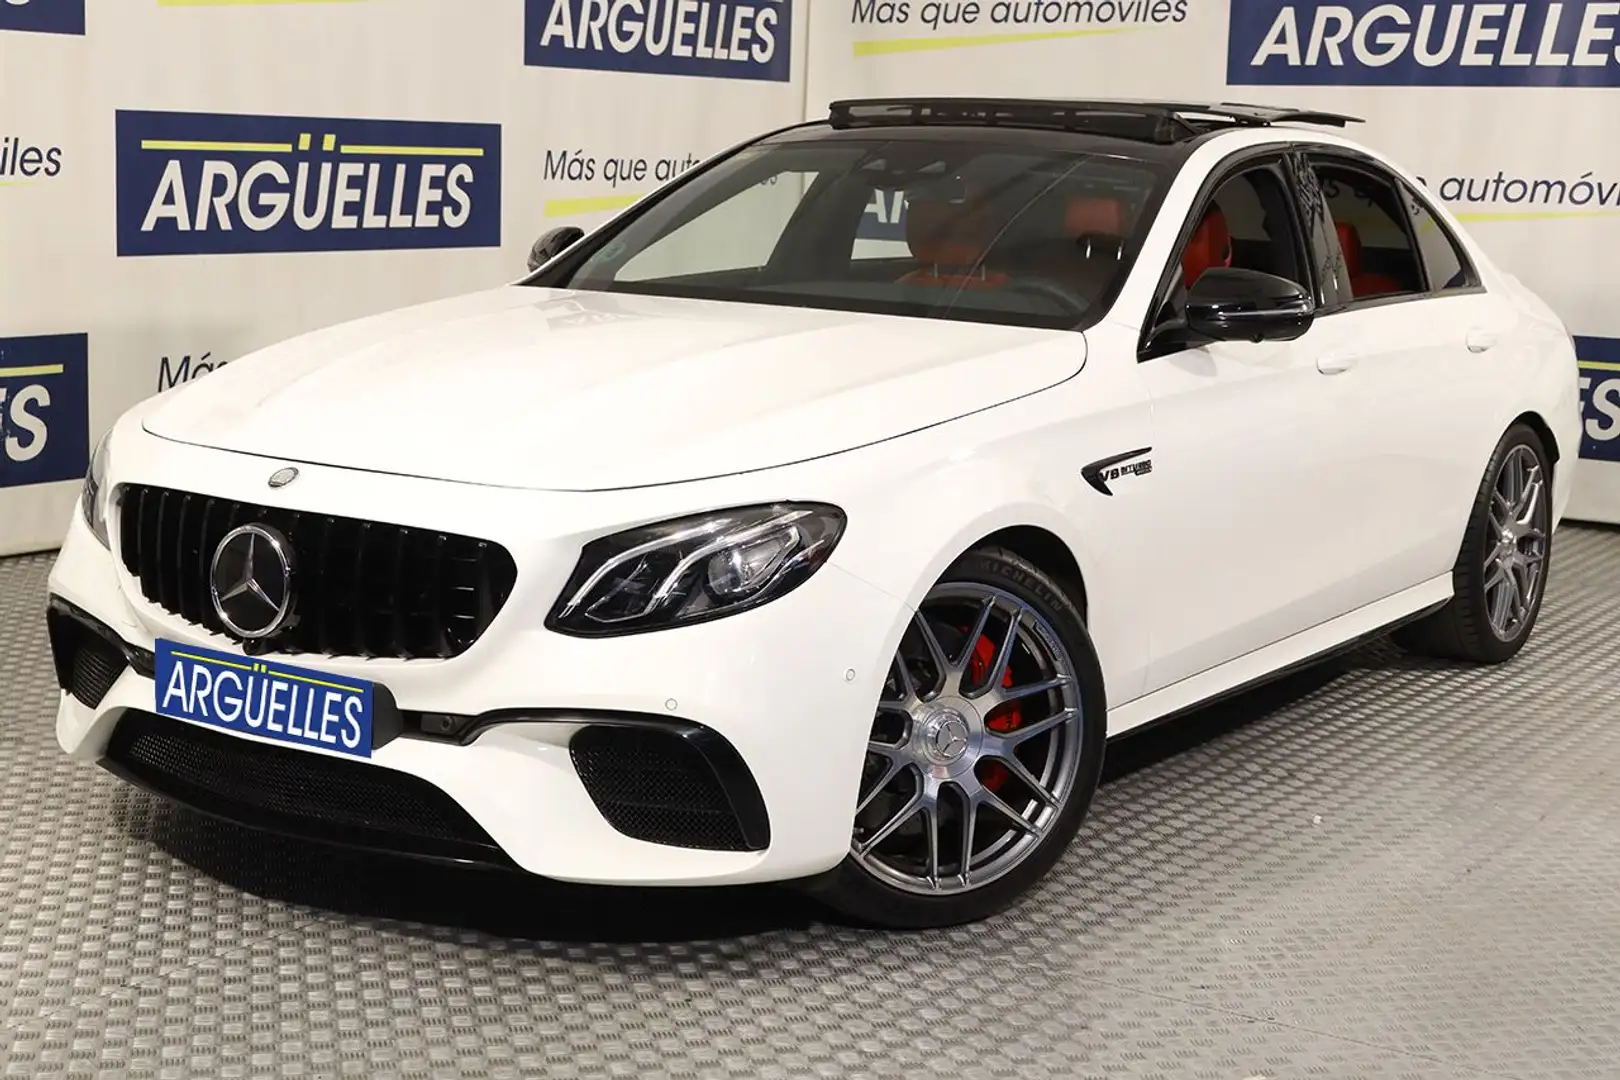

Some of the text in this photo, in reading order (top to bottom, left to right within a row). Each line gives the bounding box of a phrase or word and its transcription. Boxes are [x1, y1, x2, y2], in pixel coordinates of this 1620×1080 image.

[920, 2, 980, 31] que
[141, 133, 474, 232] ARGÜELLES
[543, 149, 596, 181] Más
[603, 158, 648, 188] que
[1439, 171, 1620, 207] automóv
[162, 662, 363, 749] ARGÜELLES
